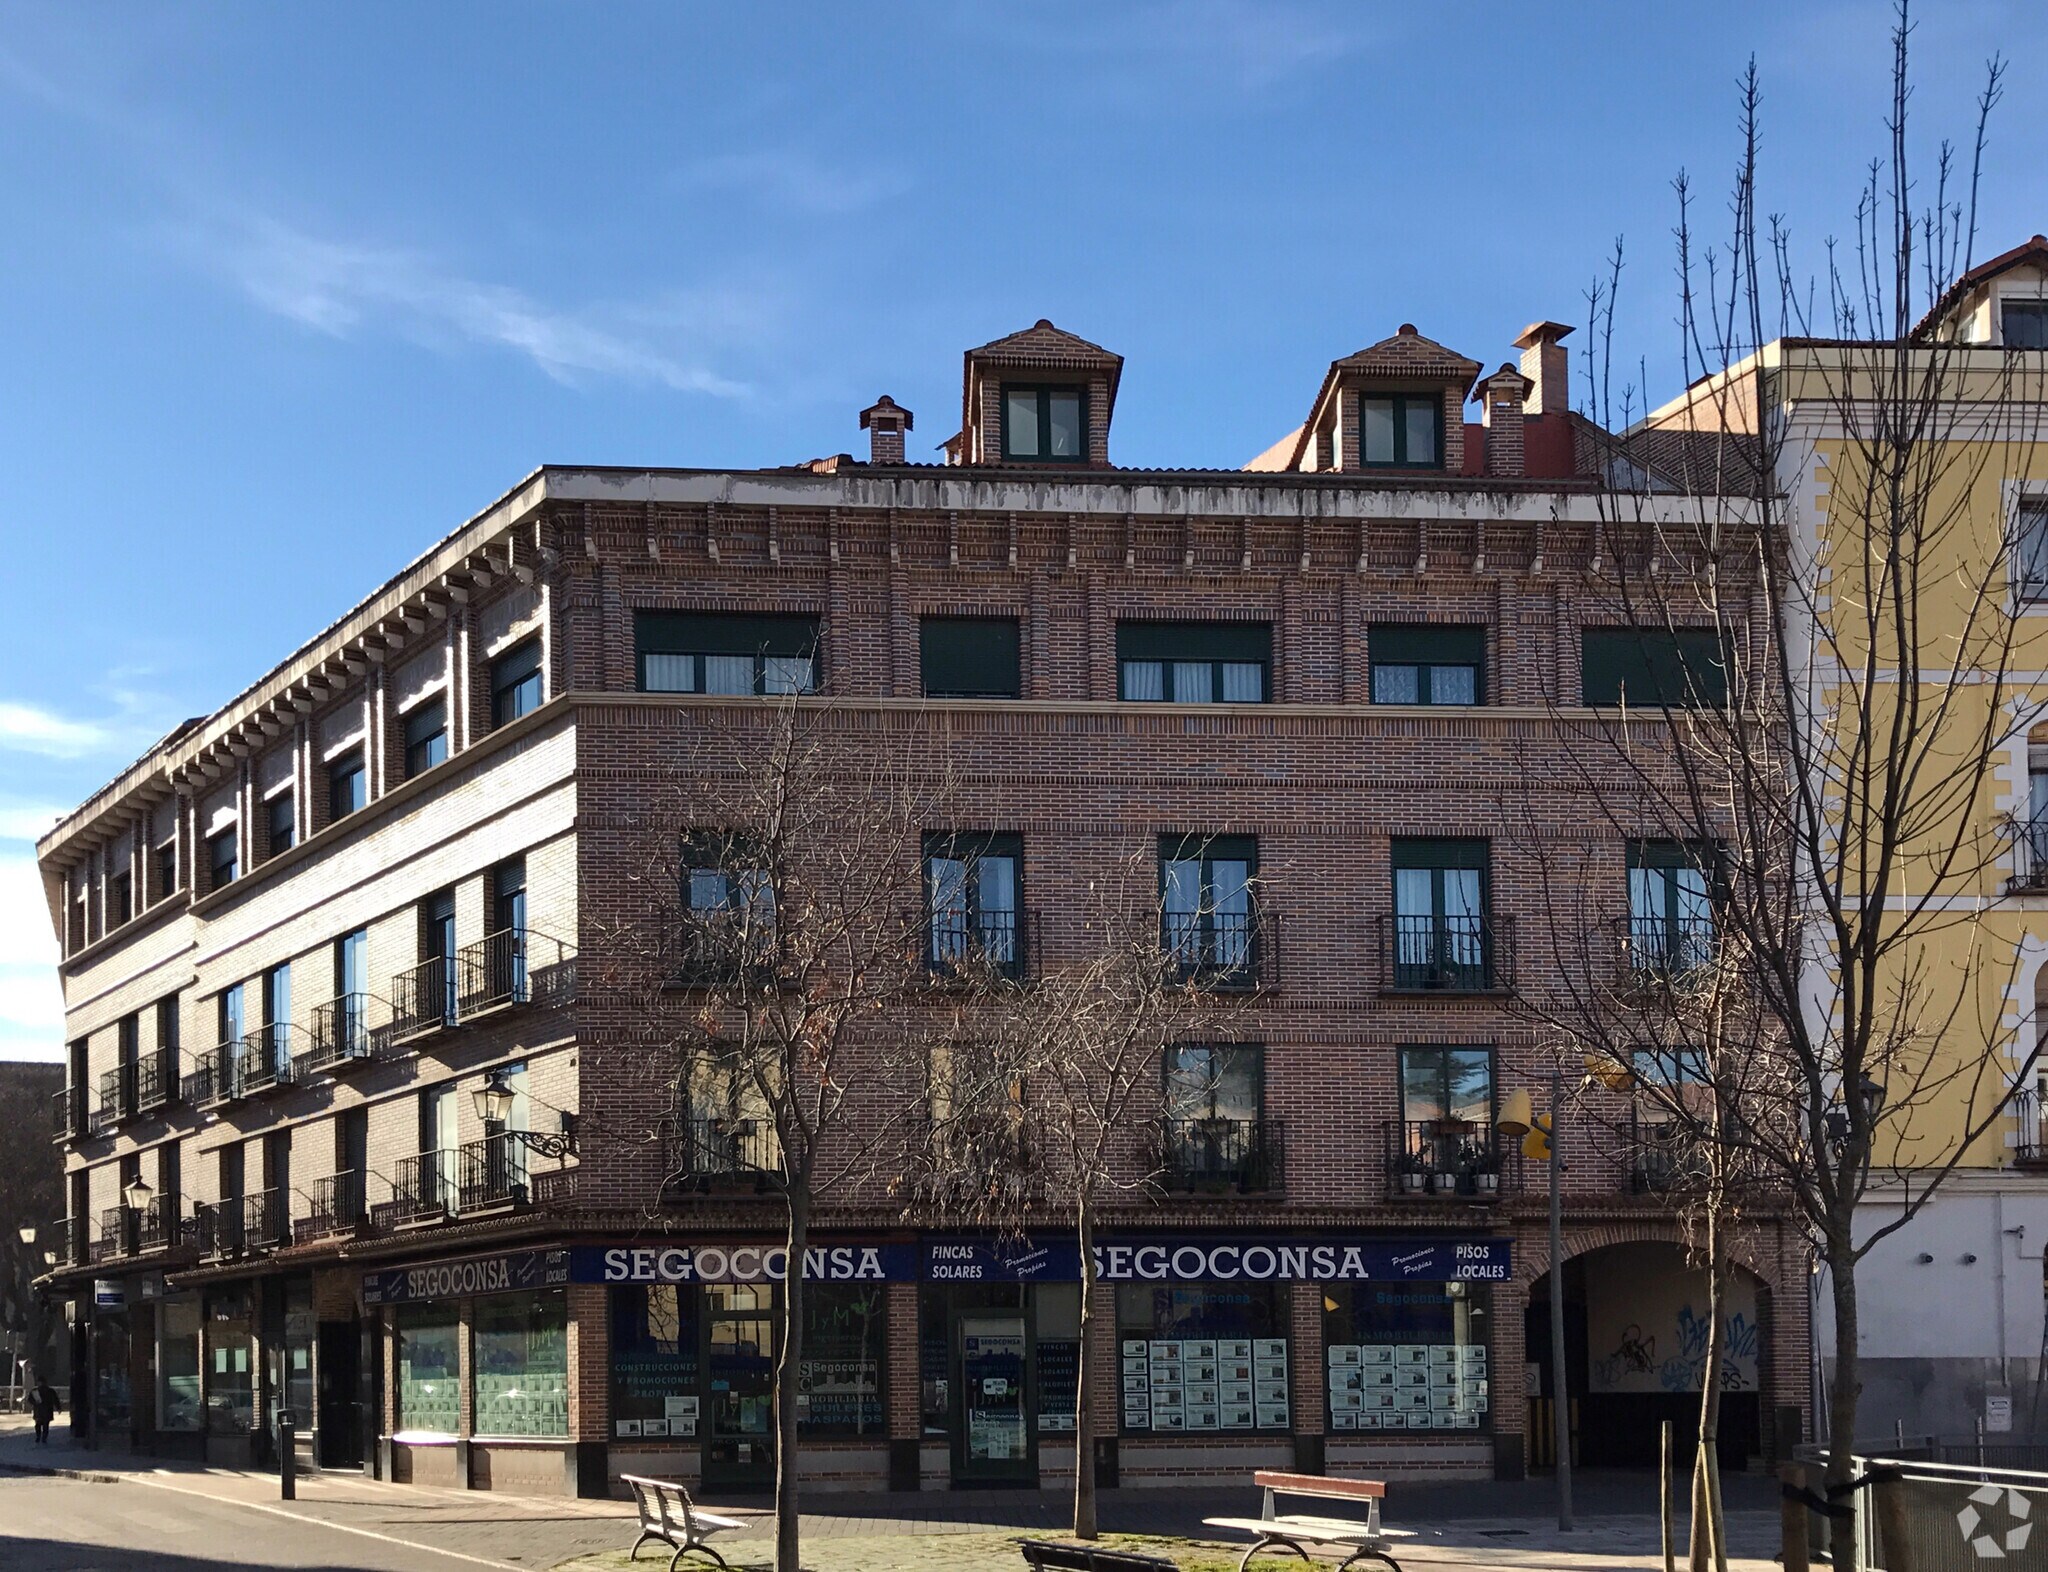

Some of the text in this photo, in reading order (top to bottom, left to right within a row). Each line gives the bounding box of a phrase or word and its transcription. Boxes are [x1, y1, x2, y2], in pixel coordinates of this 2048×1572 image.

[931, 1246, 974, 1259] FINCAS
[1004, 1247, 1049, 1269] Promociones
[1391, 1245, 1435, 1267] Promociones
[1456, 1246, 1490, 1259] PISOS
[604, 1247, 886, 1280] SEGOCONSA
[1080, 1245, 1369, 1279] SEGOCONSA
[1402, 1259, 1433, 1276] Propias
[931, 1265, 983, 1279] SOLARES
[1016, 1261, 1047, 1278] Propias
[1456, 1264, 1505, 1278] LOCALES
[407, 1258, 511, 1299] SEGOCONSA
[615, 1363, 697, 1372] CONSTRUCCIONES
[813, 1362, 876, 1374] Segoconsa
[627, 1376, 695, 1385] PROMOCIONES
[810, 1394, 878, 1403] MOBILIARIA
[811, 1403, 883, 1413] QUILERES
